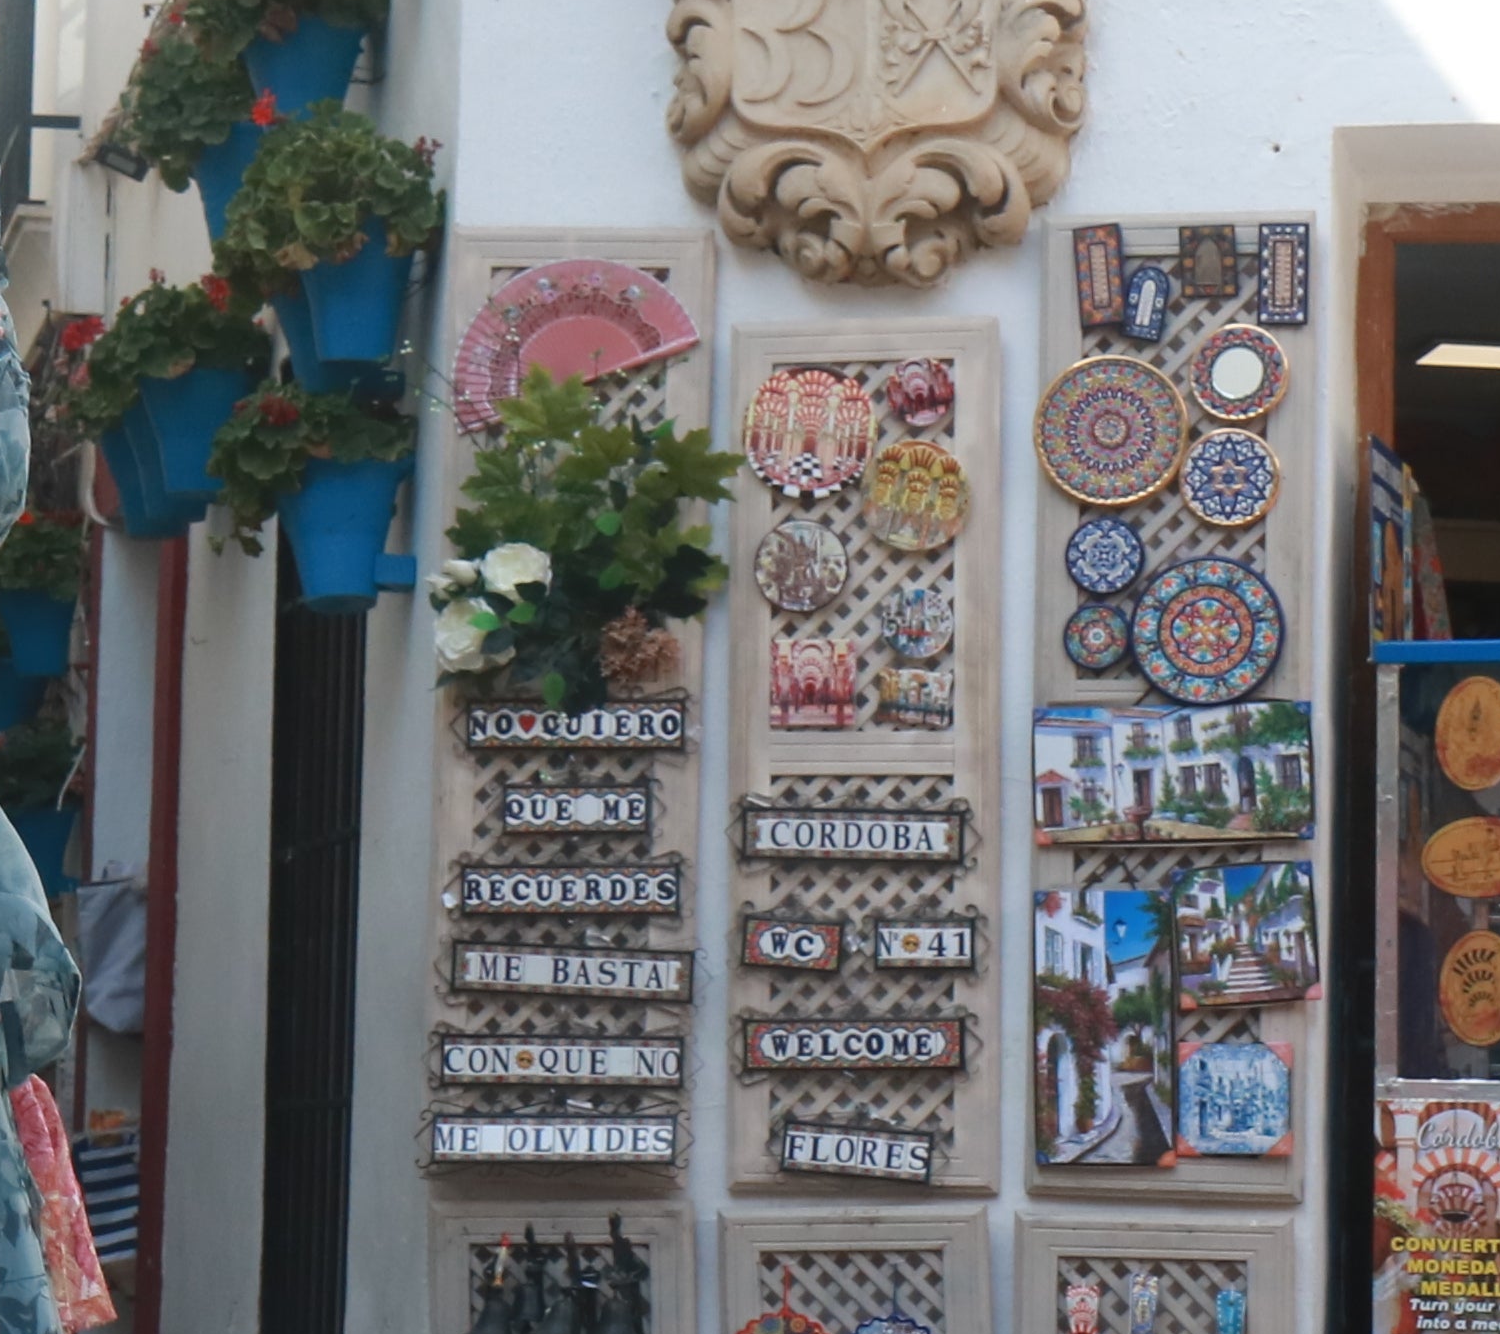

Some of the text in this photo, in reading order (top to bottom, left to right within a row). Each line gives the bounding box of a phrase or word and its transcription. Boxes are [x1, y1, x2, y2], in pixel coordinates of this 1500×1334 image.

[471, 713, 680, 736] NO QUIERO
[505, 799, 644, 820] QUE ME
[771, 821, 934, 851] CORDOBA
[465, 878, 676, 901] RECUERDES
[771, 932, 814, 957] WC
[927, 931, 968, 957] 41
[478, 954, 663, 989] ME BASTA
[771, 1033, 932, 1057] WELCOME
[444, 1047, 680, 1076] CON QUE NO
[435, 1127, 672, 1153] ME OLVIDES
[786, 1134, 929, 1171] FLORES
[1406, 1259, 1500, 1275] MONEDA
[1409, 1299, 1449, 1311] Turn
[1454, 1301, 1495, 1314] your
[1416, 1316, 1450, 1330] into
[1455, 1320, 1467, 1330] a
